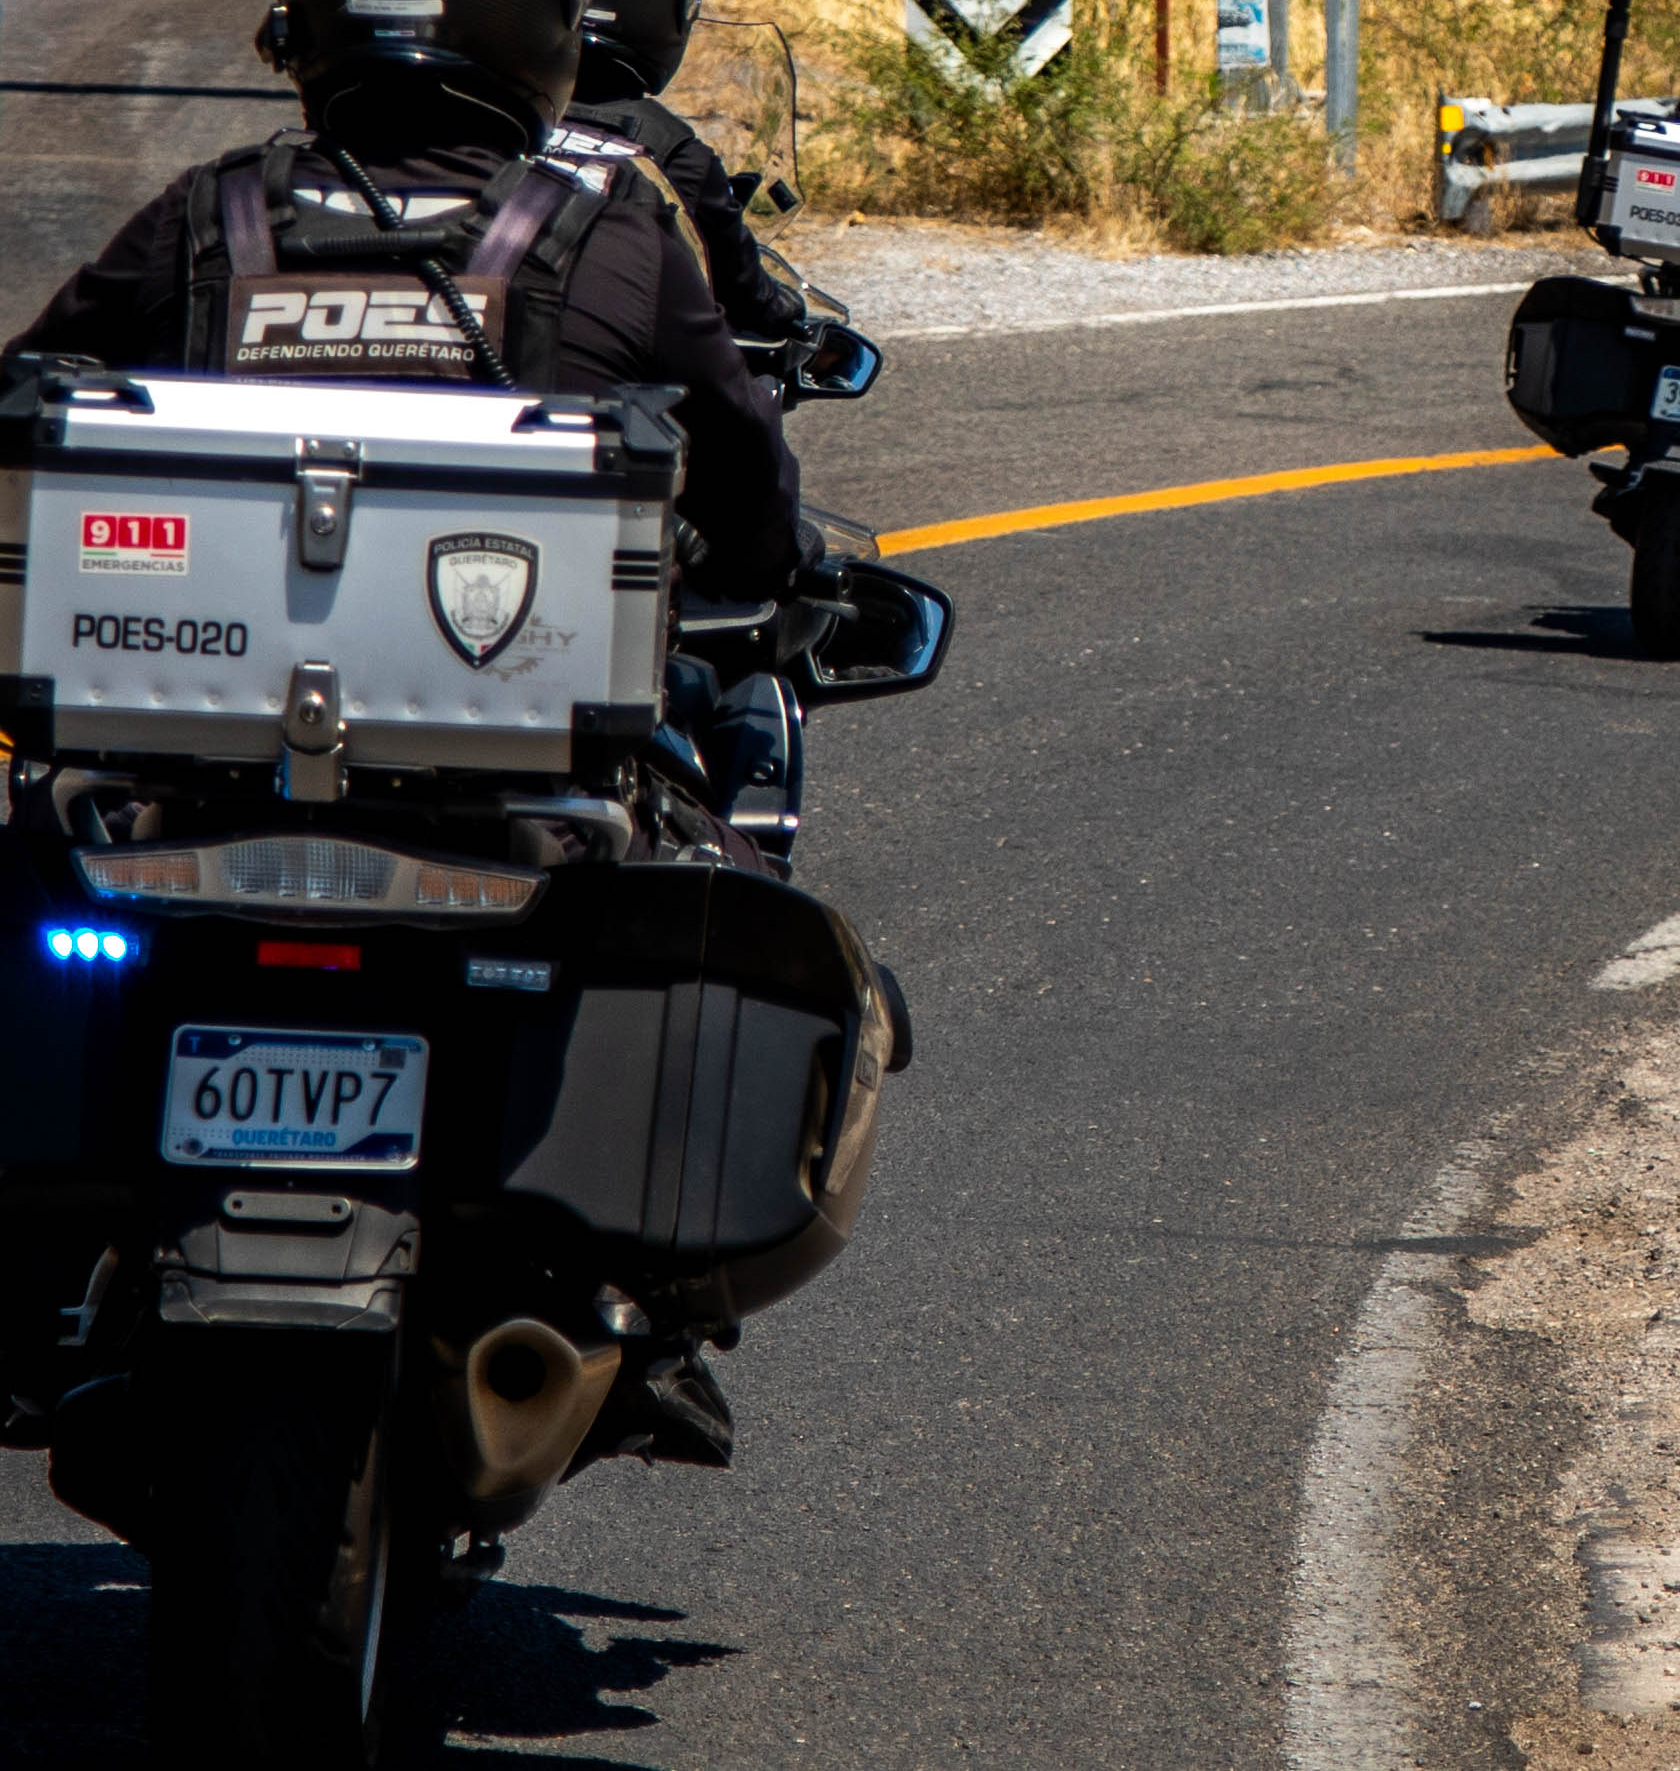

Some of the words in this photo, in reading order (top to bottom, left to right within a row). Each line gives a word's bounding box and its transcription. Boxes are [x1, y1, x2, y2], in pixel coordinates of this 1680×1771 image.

[241, 290, 488, 344] POES
[236, 343, 364, 362] DEFENDIENDO
[367, 341, 475, 362] QUERÉTARO
[89, 520, 177, 546] 911
[433, 537, 482, 555] POLICÍA
[484, 538, 535, 559] ESTATAL
[82, 559, 185, 573] EMERGENCIAS
[448, 553, 518, 569] QUERÉTARO
[72, 613, 249, 657] POES-020
[193, 1066, 399, 1126] 60TVP7
[232, 1127, 337, 1147] QUERÉTARO
